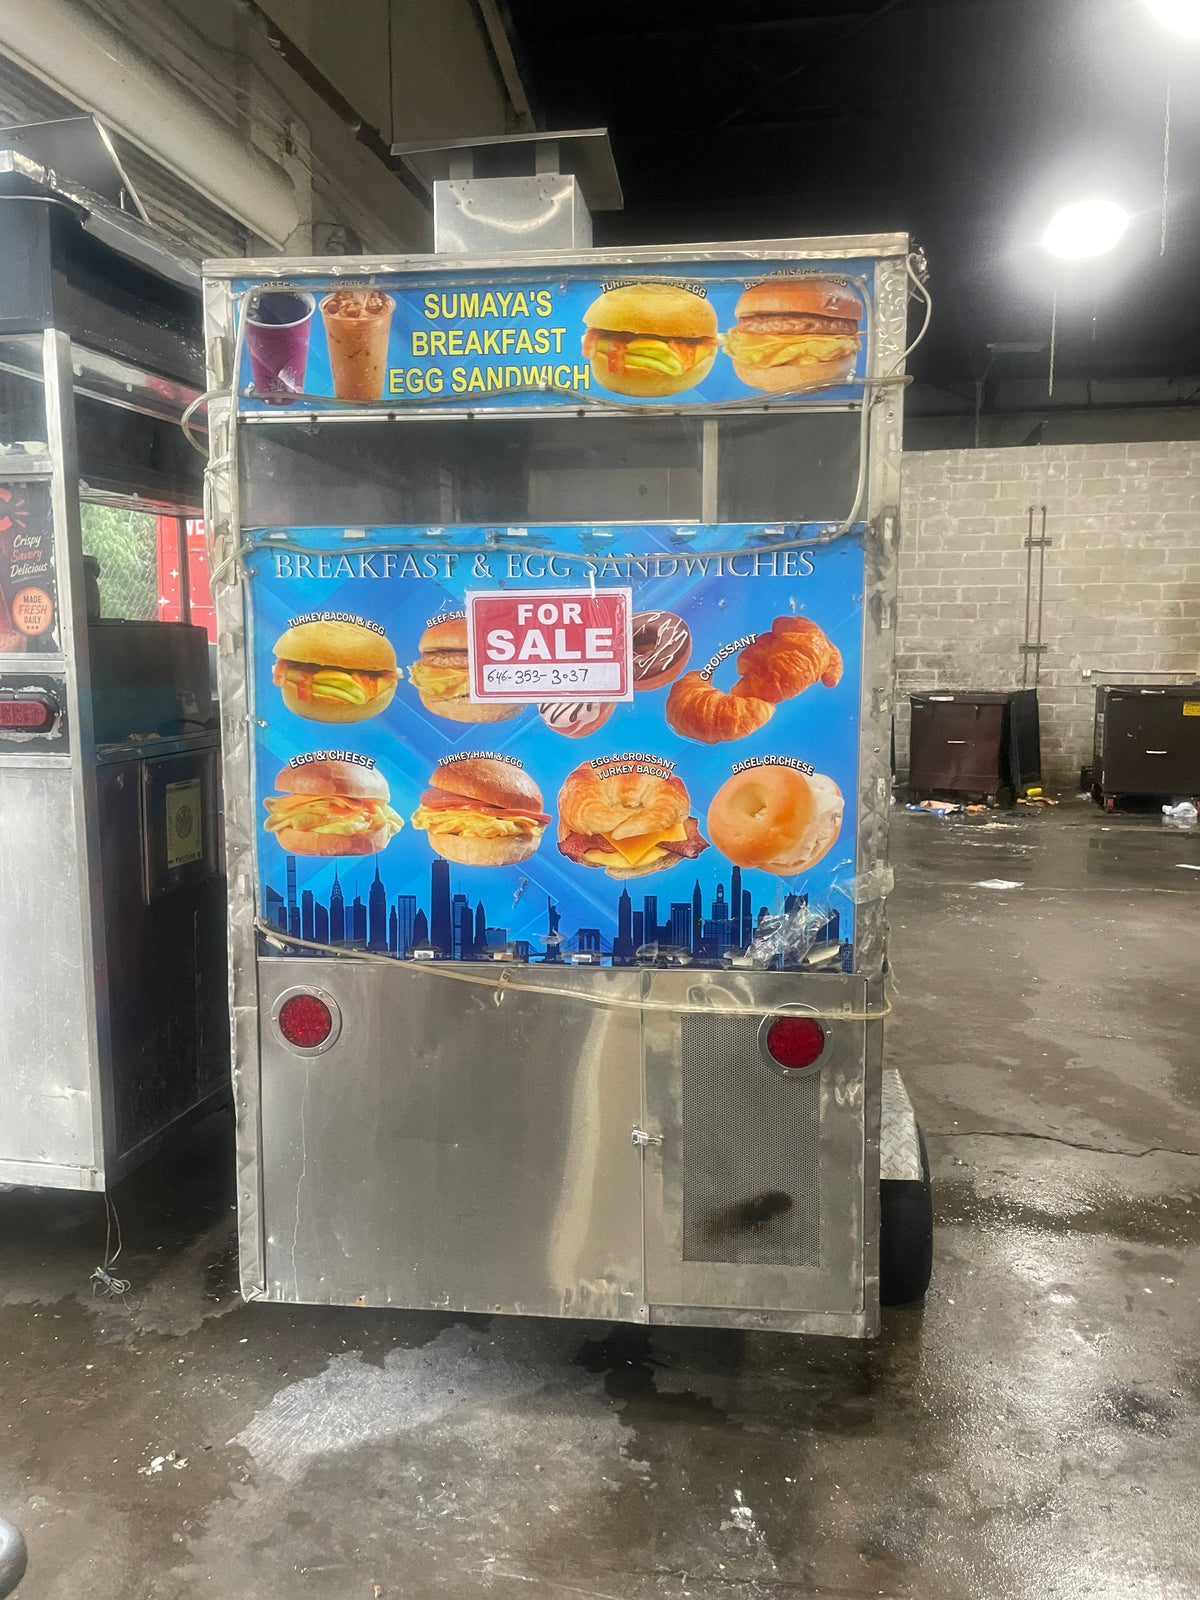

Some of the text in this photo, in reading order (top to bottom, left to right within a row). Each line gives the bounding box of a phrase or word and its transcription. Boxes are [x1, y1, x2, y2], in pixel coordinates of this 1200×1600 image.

[685, 284, 706, 299] EGG
[424, 290, 553, 319] SUMAYA'S
[411, 328, 566, 357] BREAKFAST
[389, 363, 590, 394] EGG SANDWICH
[14, 534, 41, 548] Crispy
[11, 549, 43, 563] Savory
[273, 550, 816, 579] BREAKFAST & EGG SANDWICHES
[10, 562, 48, 578] Delicious
[23, 595, 42, 604] MADE
[18, 604, 48, 615] FRESH
[517, 603, 584, 626] FOR
[24, 615, 42, 625] DAILY
[288, 611, 386, 637] TURKEY BACON & EGG
[426, 613, 448, 628] BEEF
[486, 628, 614, 661] SALE
[700, 633, 757, 681] CROISSANT
[289, 749, 376, 771] EGG & CHEESE
[437, 750, 524, 769] TURKEY HAM & EGG
[590, 752, 677, 771] EGG & CROISSANT
[731, 756, 763, 775] BAGEL
[597, 764, 671, 780] TURKEY BACON
